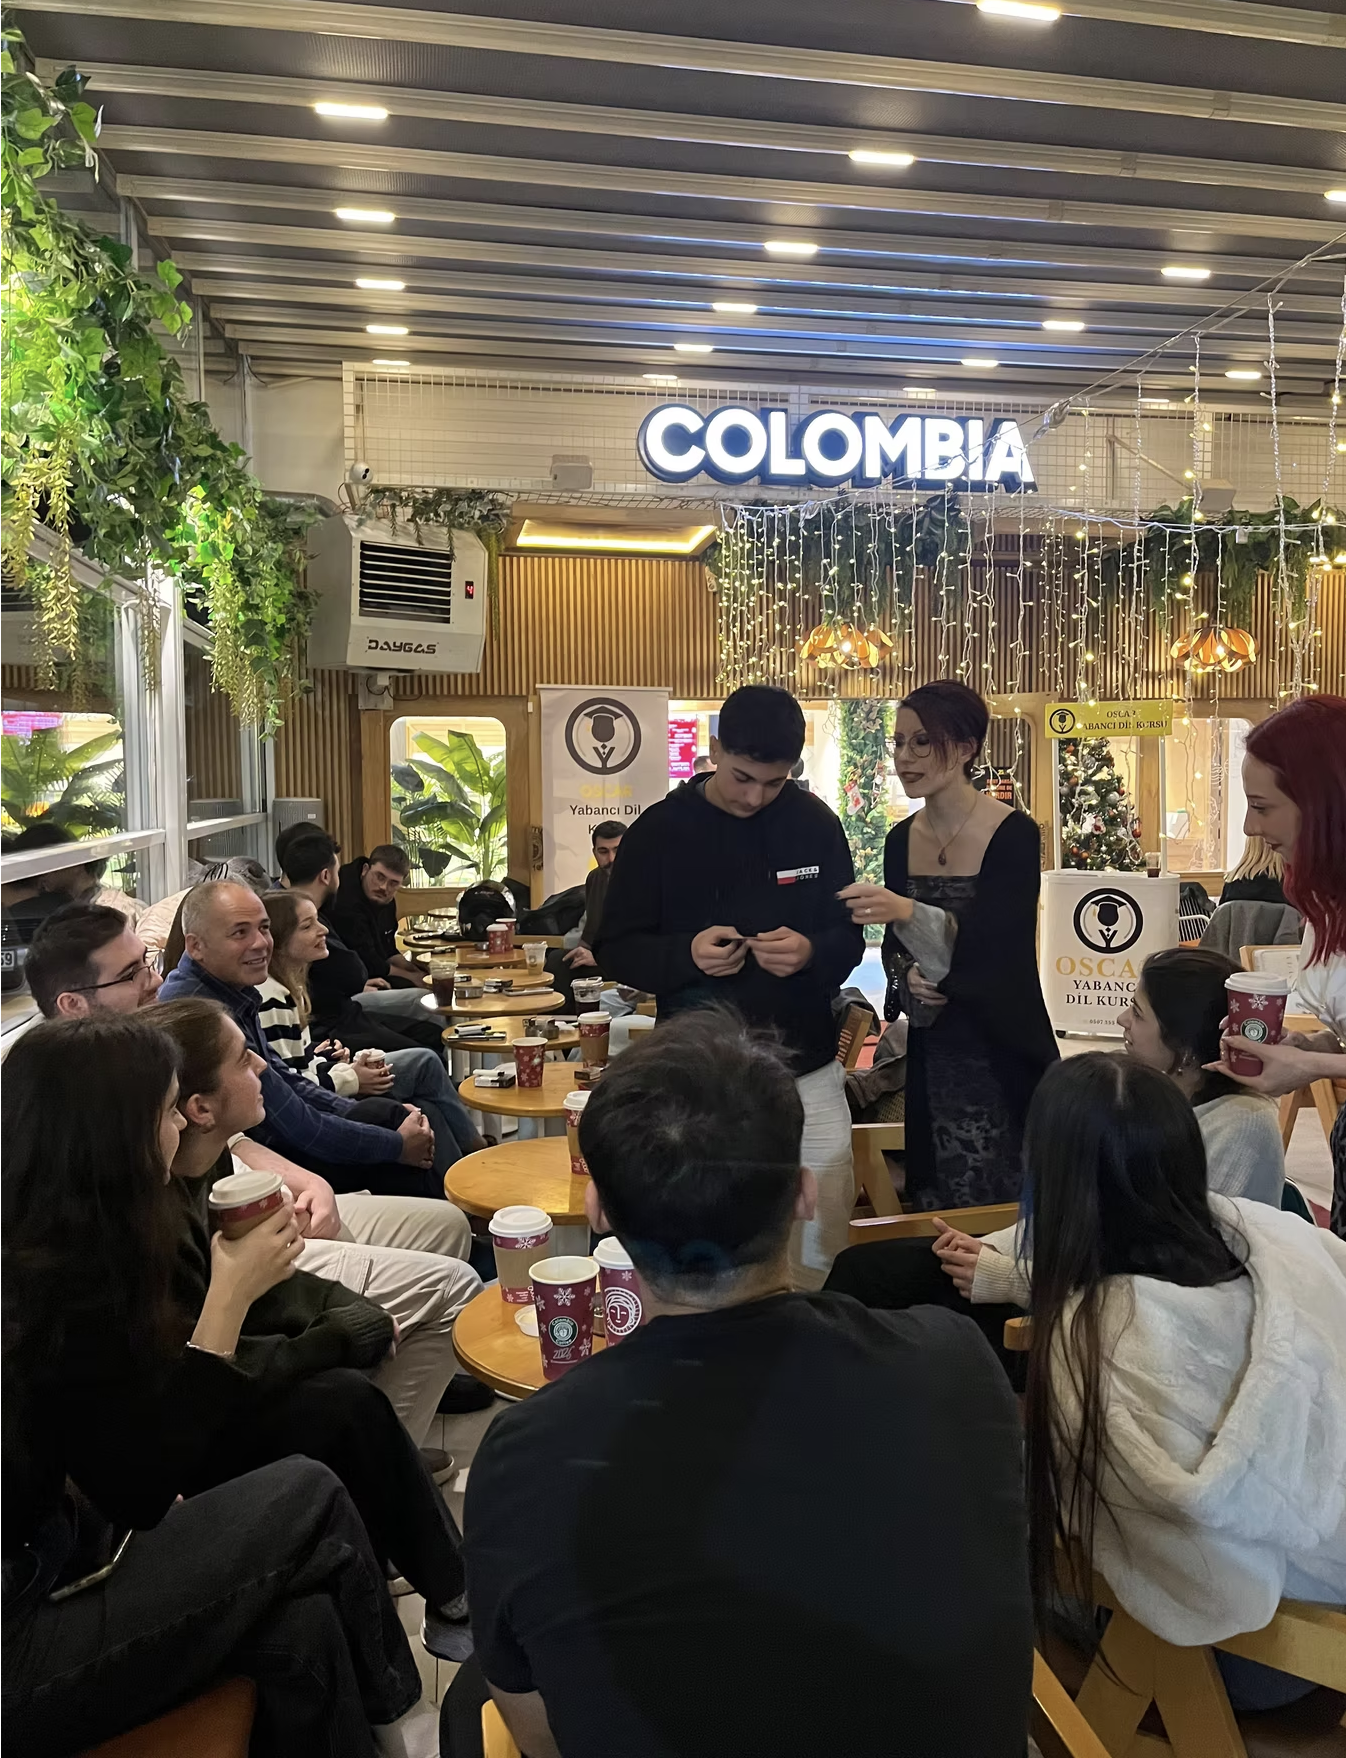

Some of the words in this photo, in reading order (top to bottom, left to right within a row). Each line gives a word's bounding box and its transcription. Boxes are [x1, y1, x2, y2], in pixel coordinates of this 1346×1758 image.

[641, 405, 1036, 486] COLOMBIA
[367, 639, 437, 655] DAYGAS
[1082, 721, 1116, 731] ABANCI
[569, 804, 620, 816] Yabancı
[624, 804, 641, 816] Dil
[1055, 956, 1138, 979] OSCA
[1073, 980, 1136, 993] YABANC
[1066, 992, 1093, 1006] DİL
